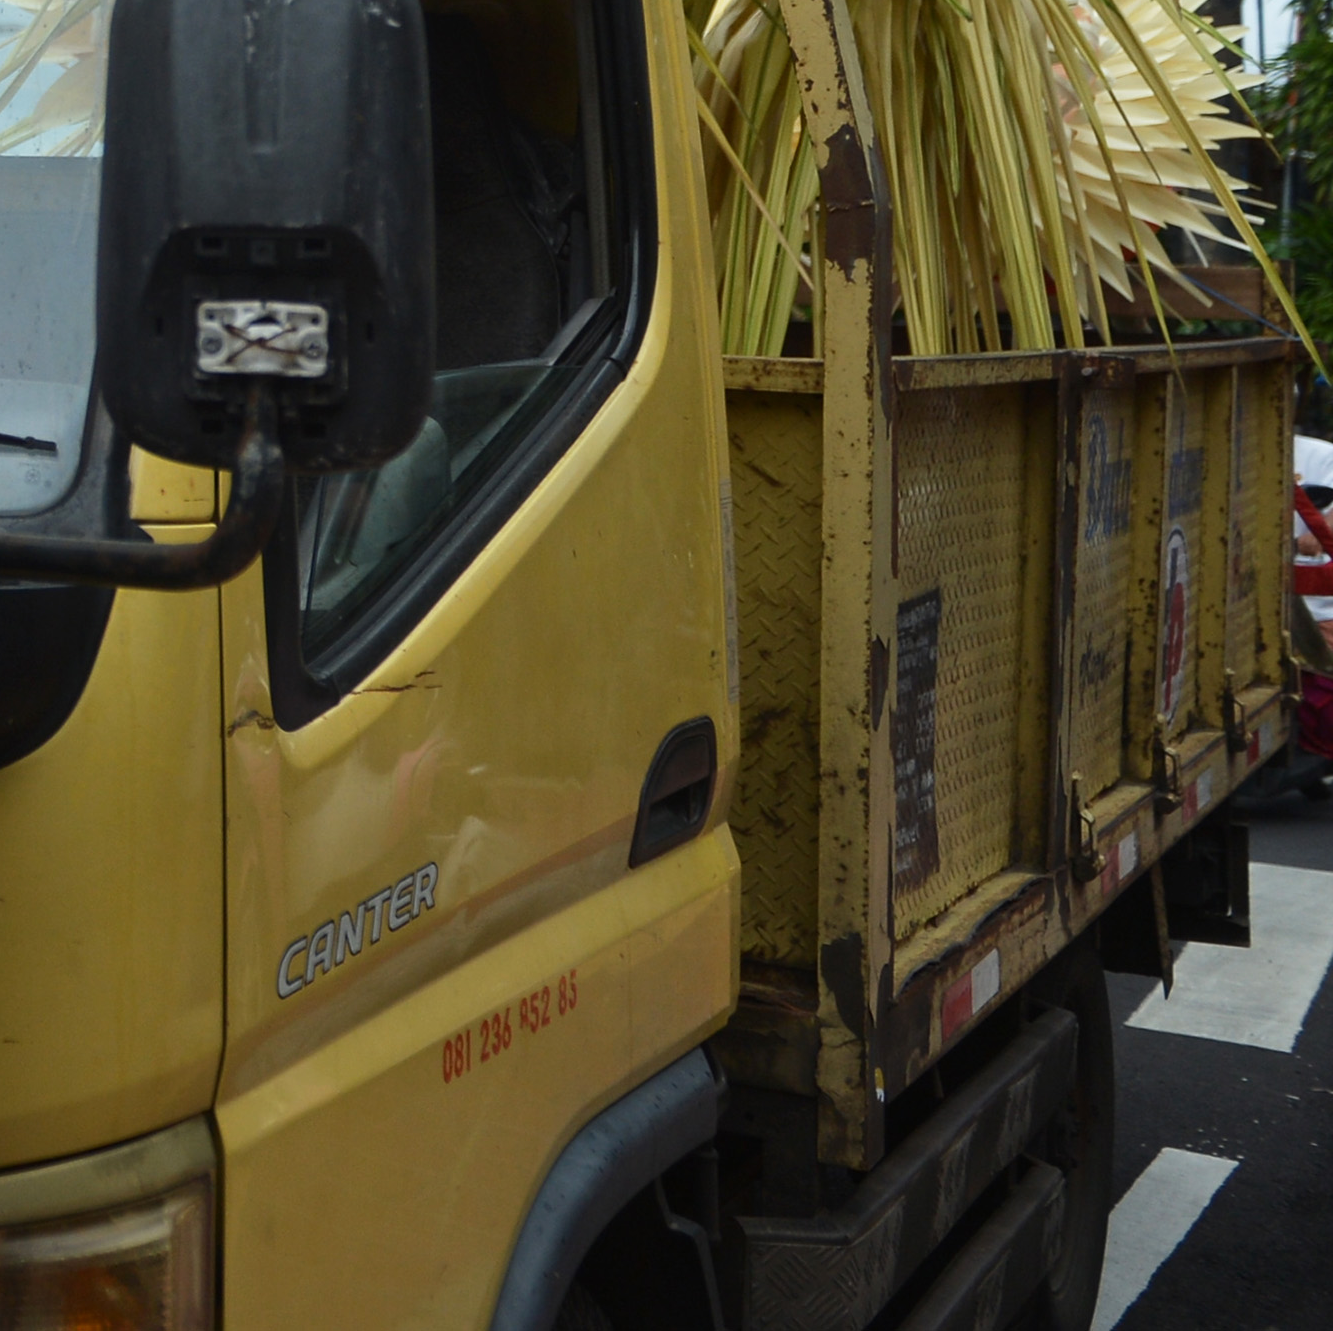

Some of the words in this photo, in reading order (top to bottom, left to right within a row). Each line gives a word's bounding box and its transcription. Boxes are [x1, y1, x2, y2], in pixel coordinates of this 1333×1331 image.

[277, 861, 439, 1000] CANTER
[442, 1029, 472, 1084] 081
[480, 1007, 512, 1063] 236
